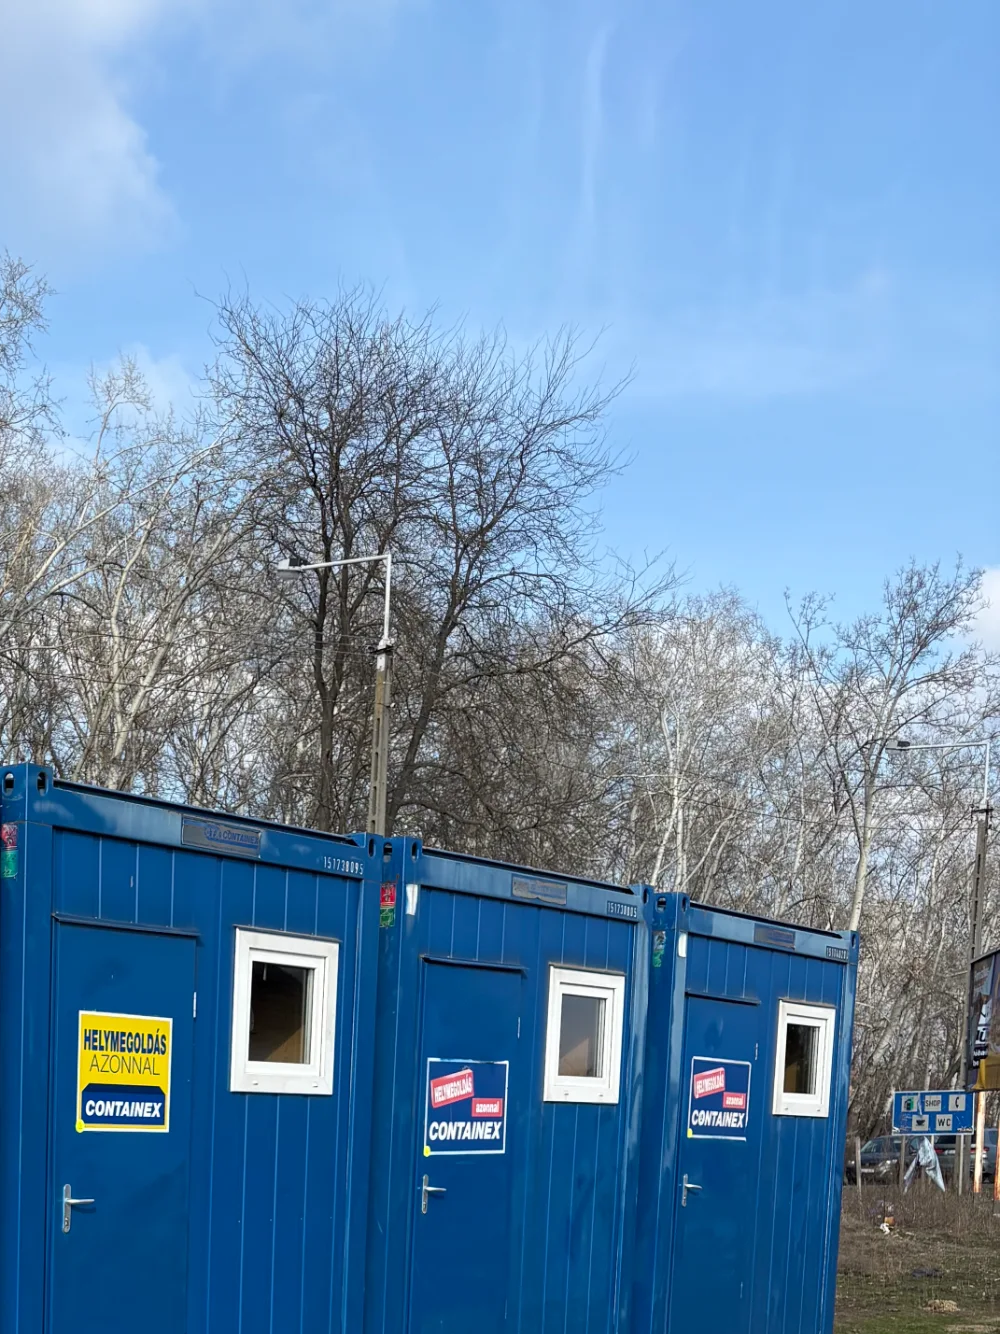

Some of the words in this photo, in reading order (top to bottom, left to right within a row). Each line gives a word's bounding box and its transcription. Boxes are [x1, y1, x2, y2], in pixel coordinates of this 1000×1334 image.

[83, 1028, 167, 1055] HELYMEGOLDÁS
[89, 1054, 161, 1076] AZONNAL
[85, 1099, 162, 1117] CONTAINEX
[475, 1100, 500, 1113] azonnal
[925, 1099, 941, 1107] SHOP
[691, 1109, 746, 1128] CONTAINEX
[937, 1118, 951, 1127] WC
[428, 1121, 503, 1140] CONTAINEX
